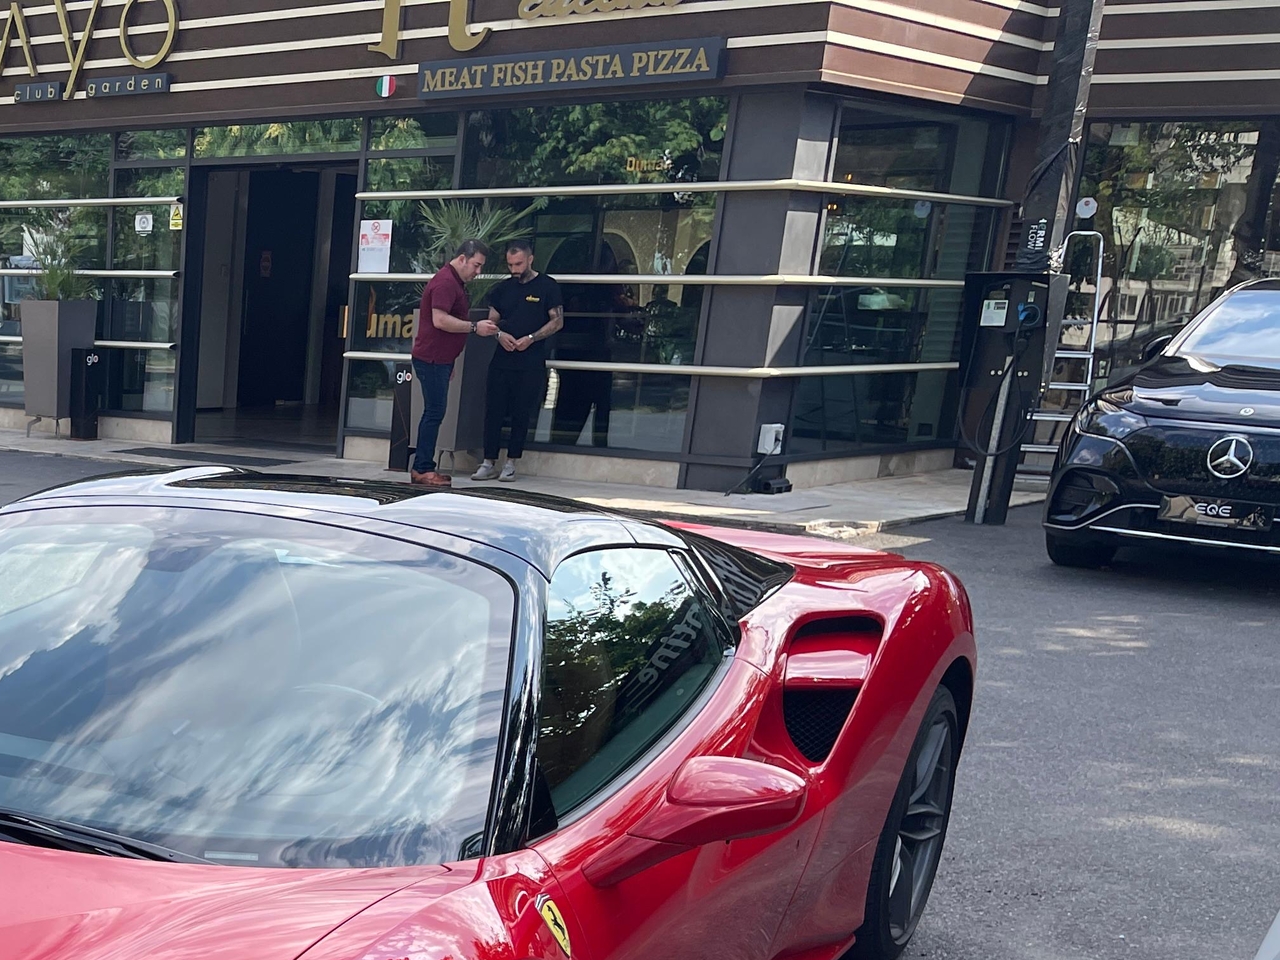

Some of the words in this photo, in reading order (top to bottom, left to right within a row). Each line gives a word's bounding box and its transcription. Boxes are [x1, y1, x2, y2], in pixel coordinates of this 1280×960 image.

[422, 64, 488, 93] MEAT
[490, 59, 545, 88] FISH
[550, 53, 624, 82] PASTA
[631, 47, 711, 76] PIZZA
[14, 83, 56, 101] club
[87, 75, 163, 97] garden
[1026, 224, 1038, 250] FLOW
[86, 353, 99, 366] glo
[396, 369, 412, 384] glo
[1194, 502, 1233, 517] EQE
